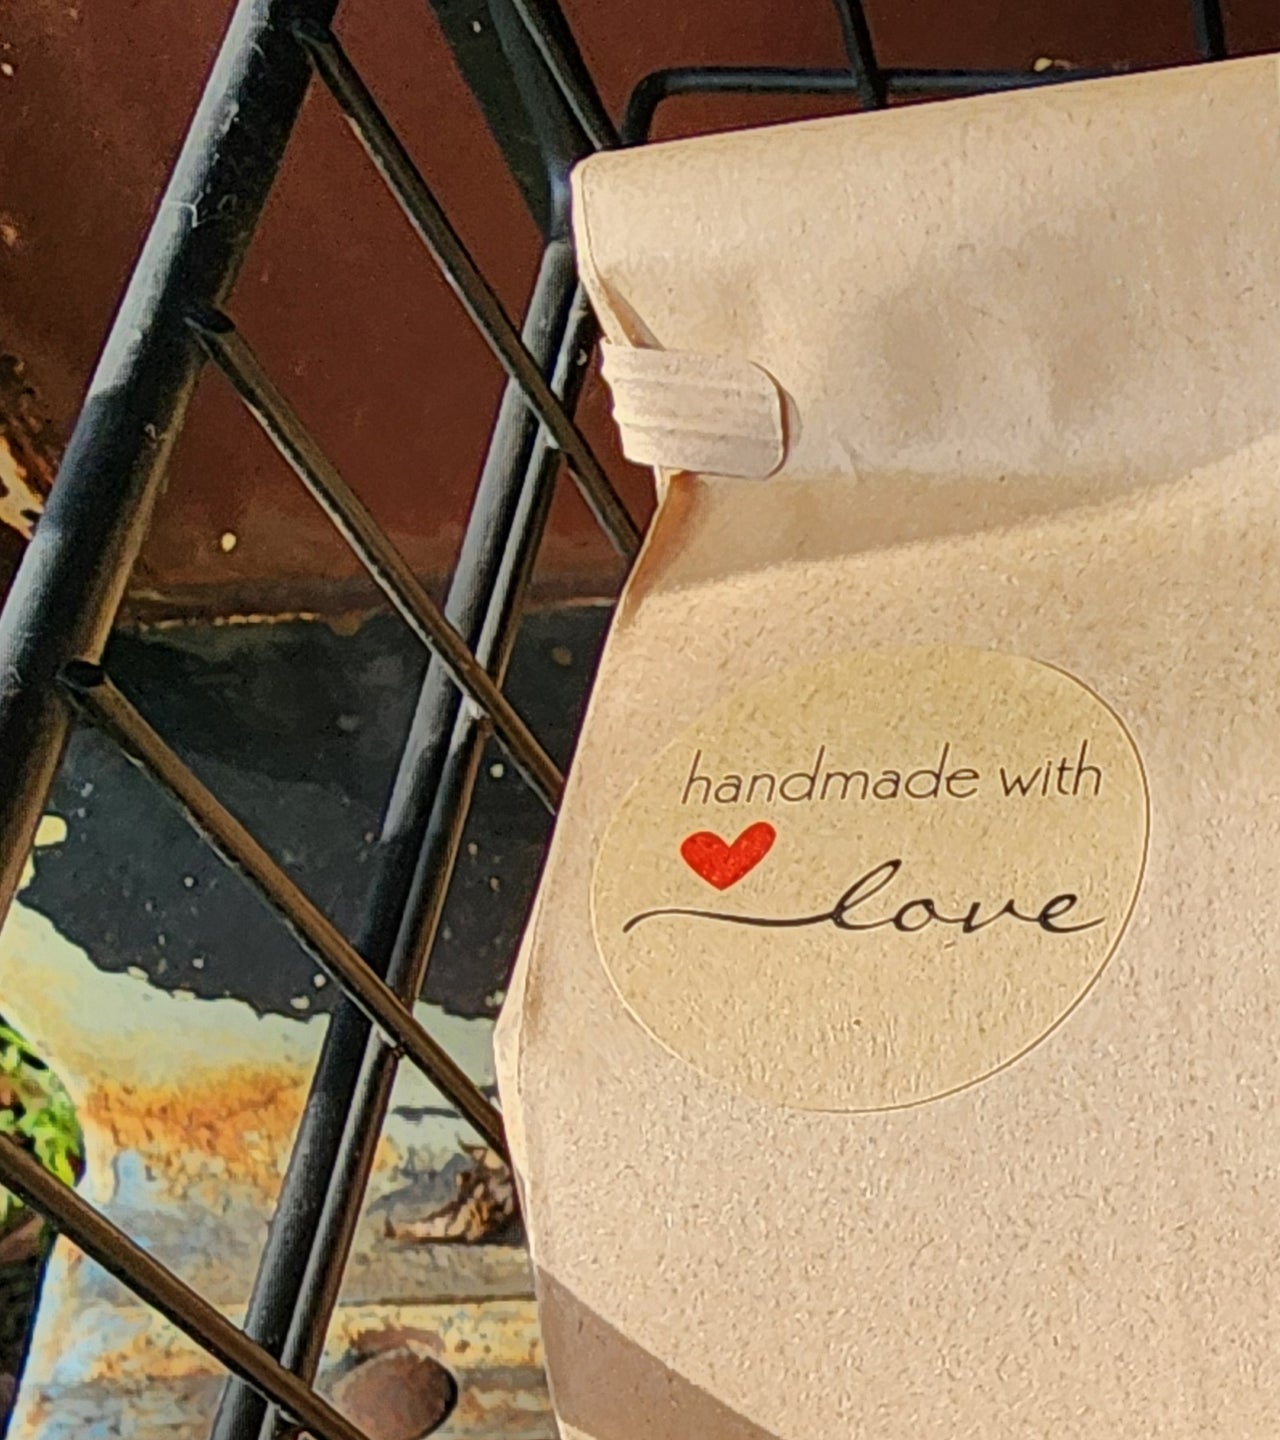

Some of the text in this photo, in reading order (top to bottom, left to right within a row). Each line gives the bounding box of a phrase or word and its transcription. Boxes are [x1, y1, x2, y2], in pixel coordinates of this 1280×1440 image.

[681, 739, 1102, 804] handmade with
[623, 858, 1105, 935] love
